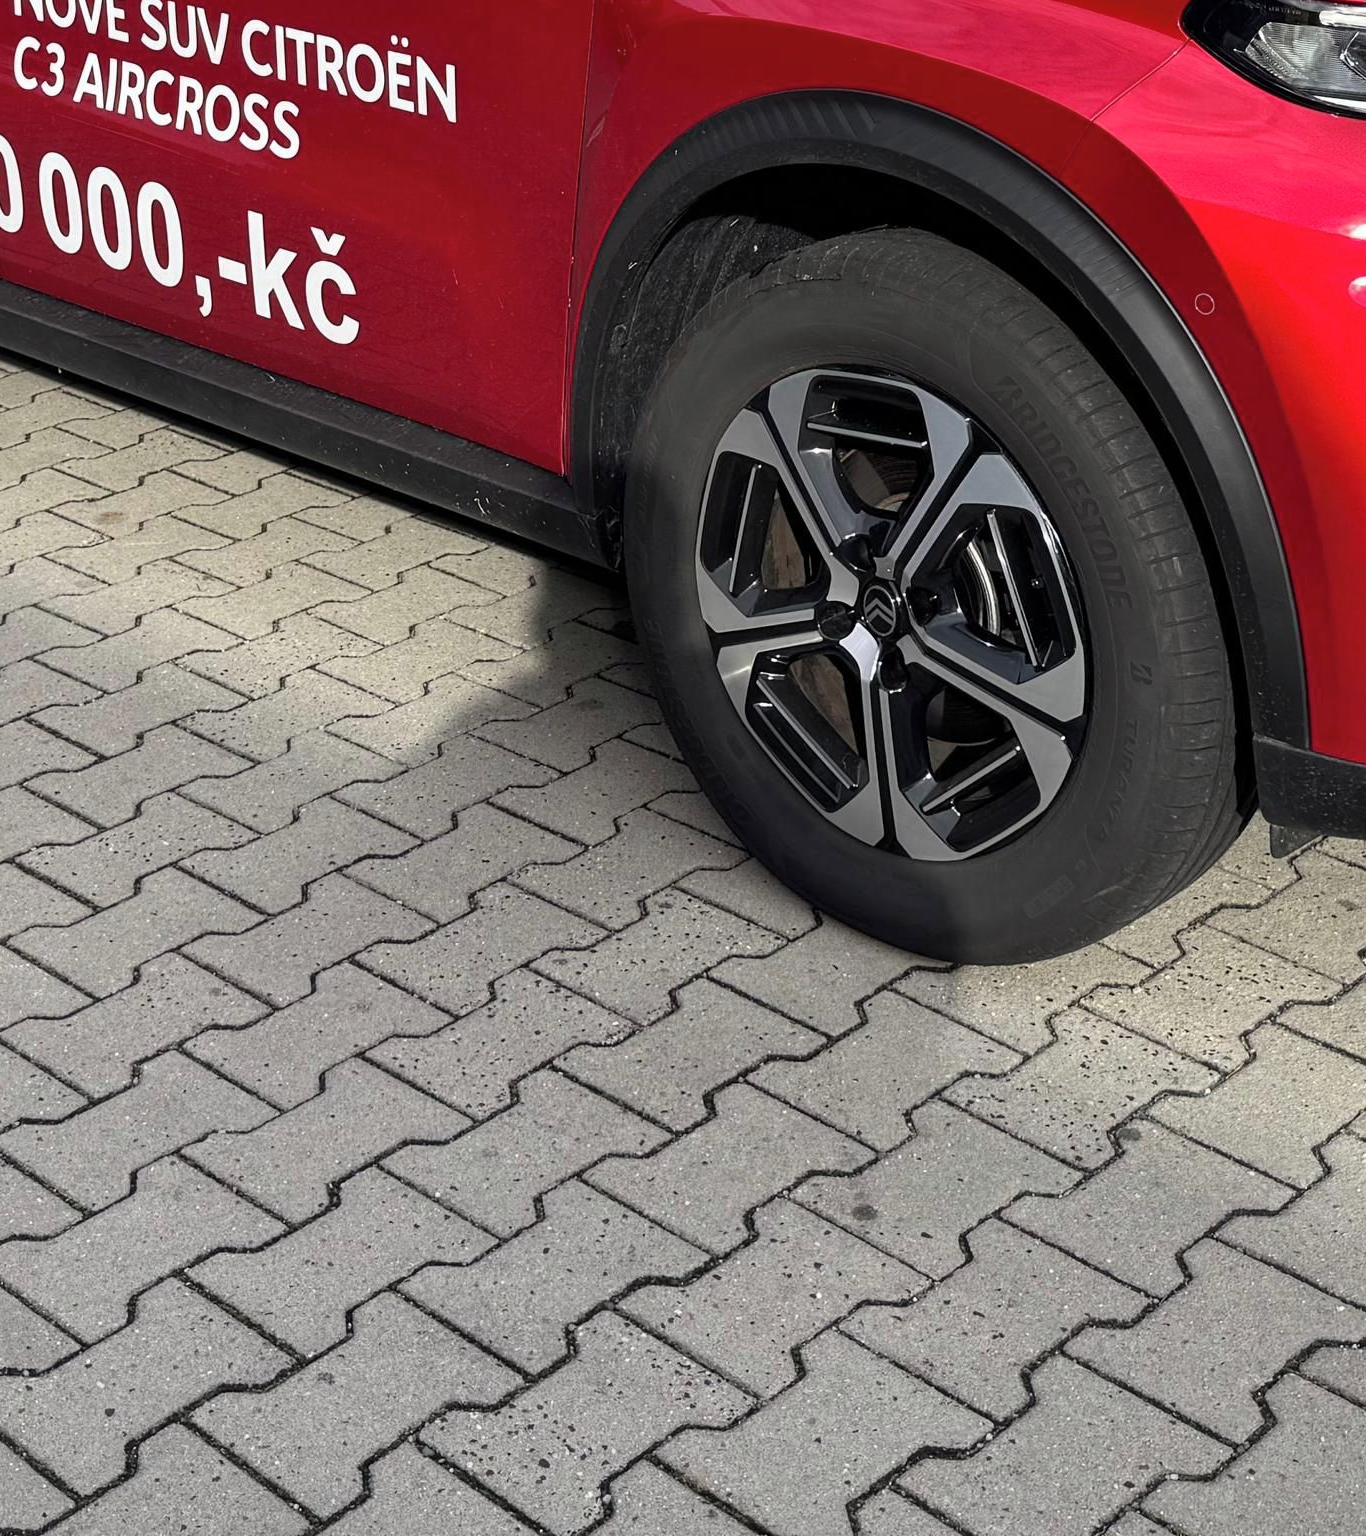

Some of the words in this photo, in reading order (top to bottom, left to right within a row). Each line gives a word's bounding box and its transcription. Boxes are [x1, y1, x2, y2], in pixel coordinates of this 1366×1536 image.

[12, 36, 66, 97] C3
[73, 59, 301, 160] AIRCROSS
[240, 19, 457, 124] CITROËN
